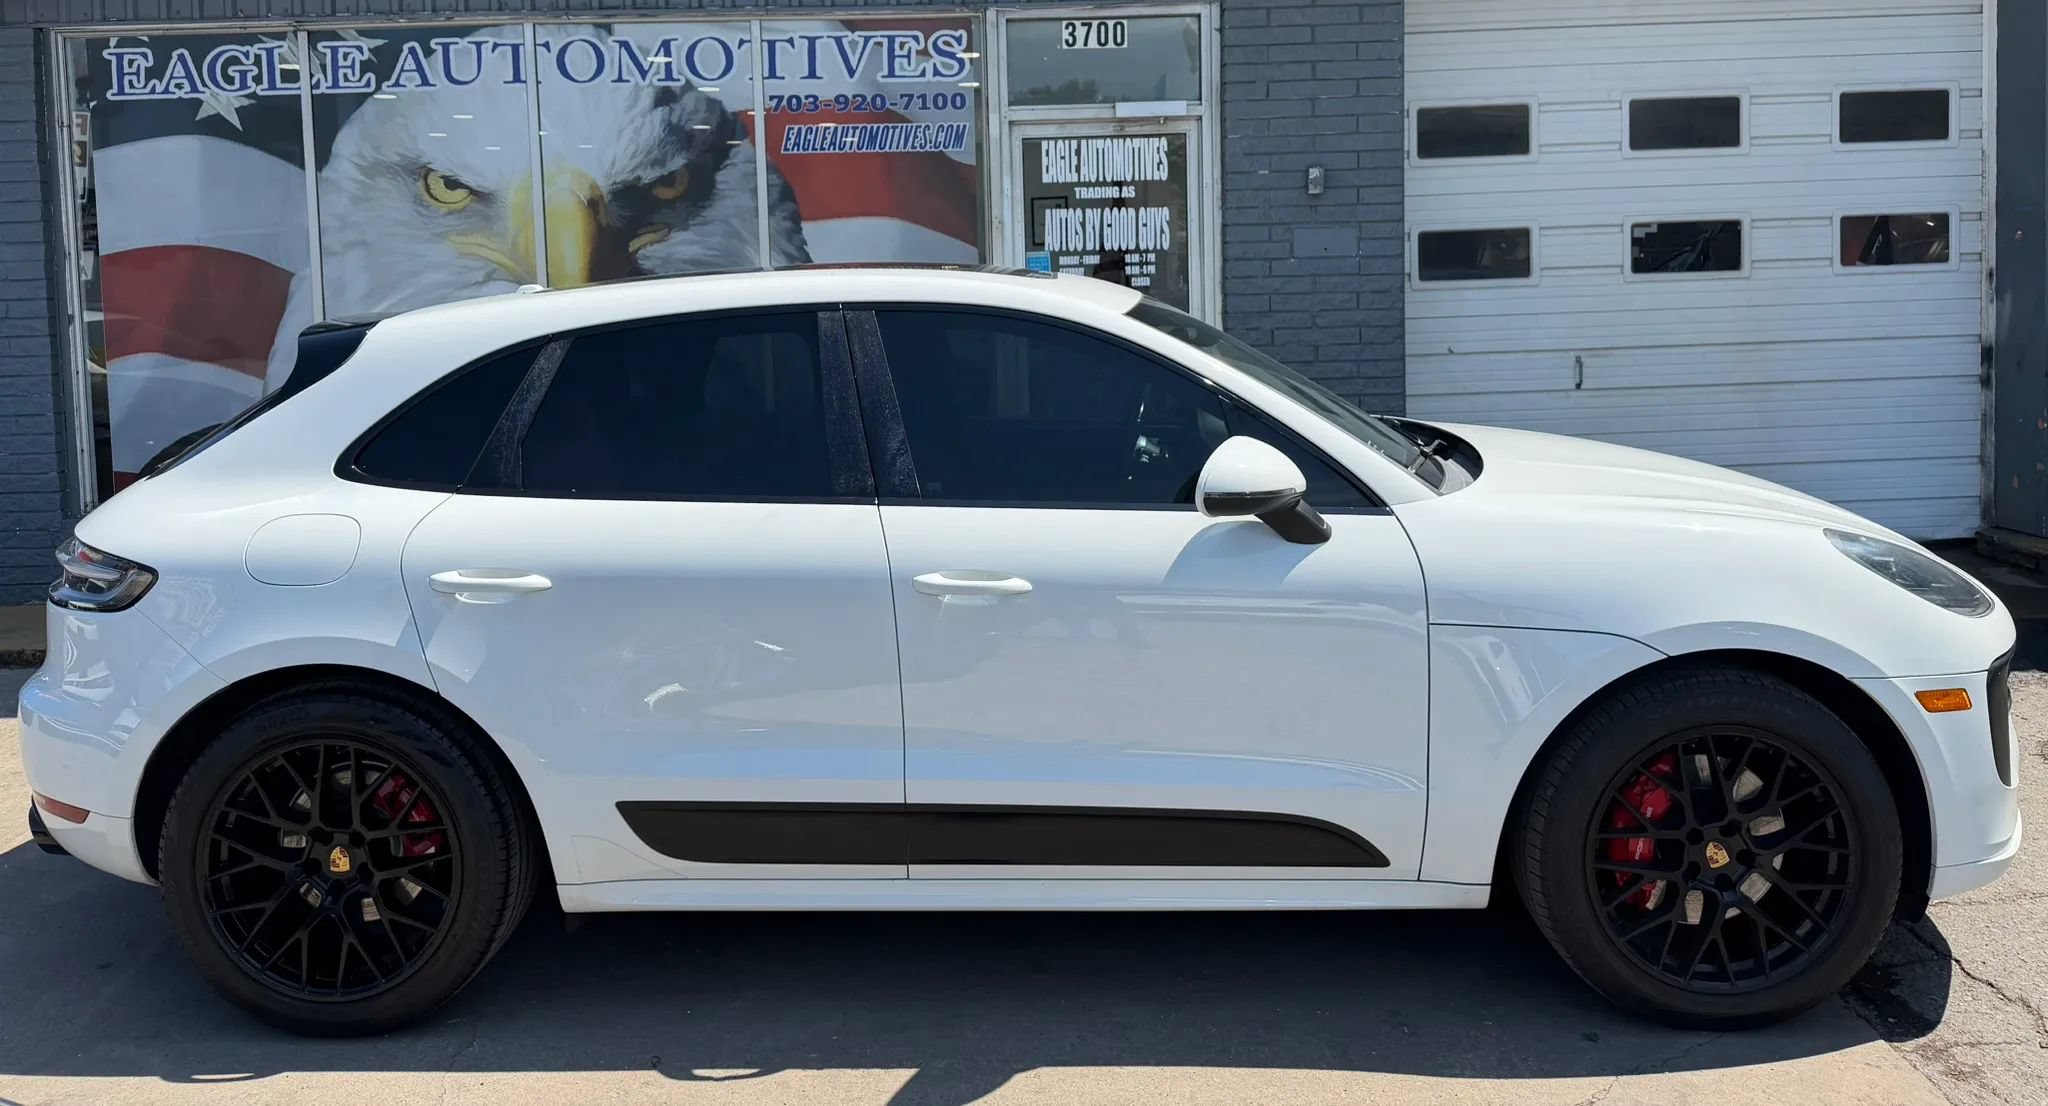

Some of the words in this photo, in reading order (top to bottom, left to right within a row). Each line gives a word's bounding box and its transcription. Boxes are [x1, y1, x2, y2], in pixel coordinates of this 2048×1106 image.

[1064, 20, 1126, 48] 3700
[105, 39, 376, 98] EAGLE
[386, 30, 969, 88] AUTOMOTIVES
[769, 92, 967, 113] 703-920-7100
[782, 123, 968, 153] EAGLEAUTOMOTIVES.COM
[1042, 139, 1078, 184] EAGLE
[1080, 137, 1169, 182] AUTOMOTIVES
[1074, 187, 1119, 199] TRADING
[1121, 186, 1136, 198] AS
[1044, 208, 1084, 252] AUTOS
[1085, 208, 1101, 251] BY
[1103, 207, 1136, 251] GOOD
[1138, 206, 1170, 250] GUYS
